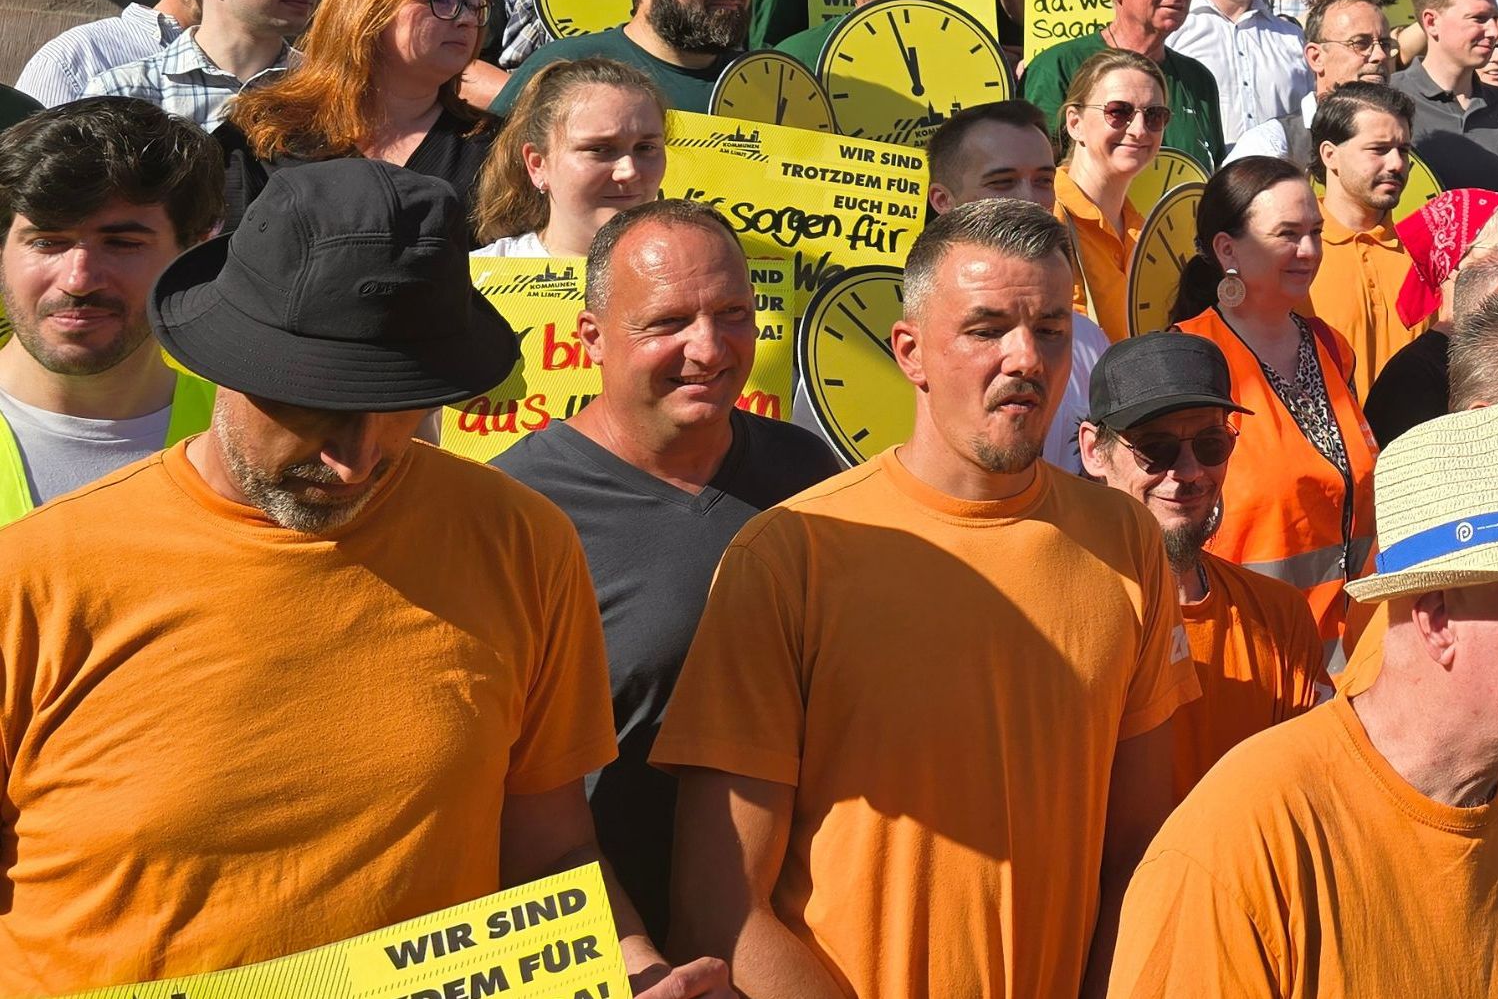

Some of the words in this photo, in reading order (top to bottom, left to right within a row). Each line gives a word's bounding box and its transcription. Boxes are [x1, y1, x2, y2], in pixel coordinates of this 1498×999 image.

[722, 142, 760, 150] KOMMUNEN
[839, 145, 875, 163] WIR
[880, 151, 923, 170] SIND
[781, 162, 882, 189] TROTZDEM
[886, 177, 921, 196] FÜR
[834, 195, 882, 214] EUCH
[887, 203, 918, 220] DA!
[731, 202, 842, 248] sorgen
[845, 213, 909, 253] für
[530, 281, 577, 290] KOMMUNEN
[750, 269, 784, 284] ND
[755, 294, 785, 312] ÜR
[759, 324, 784, 341] A!
[458, 393, 550, 436] aus
[384, 923, 475, 970] WIR
[486, 888, 587, 940] SIND
[518, 934, 603, 984] FÜR
